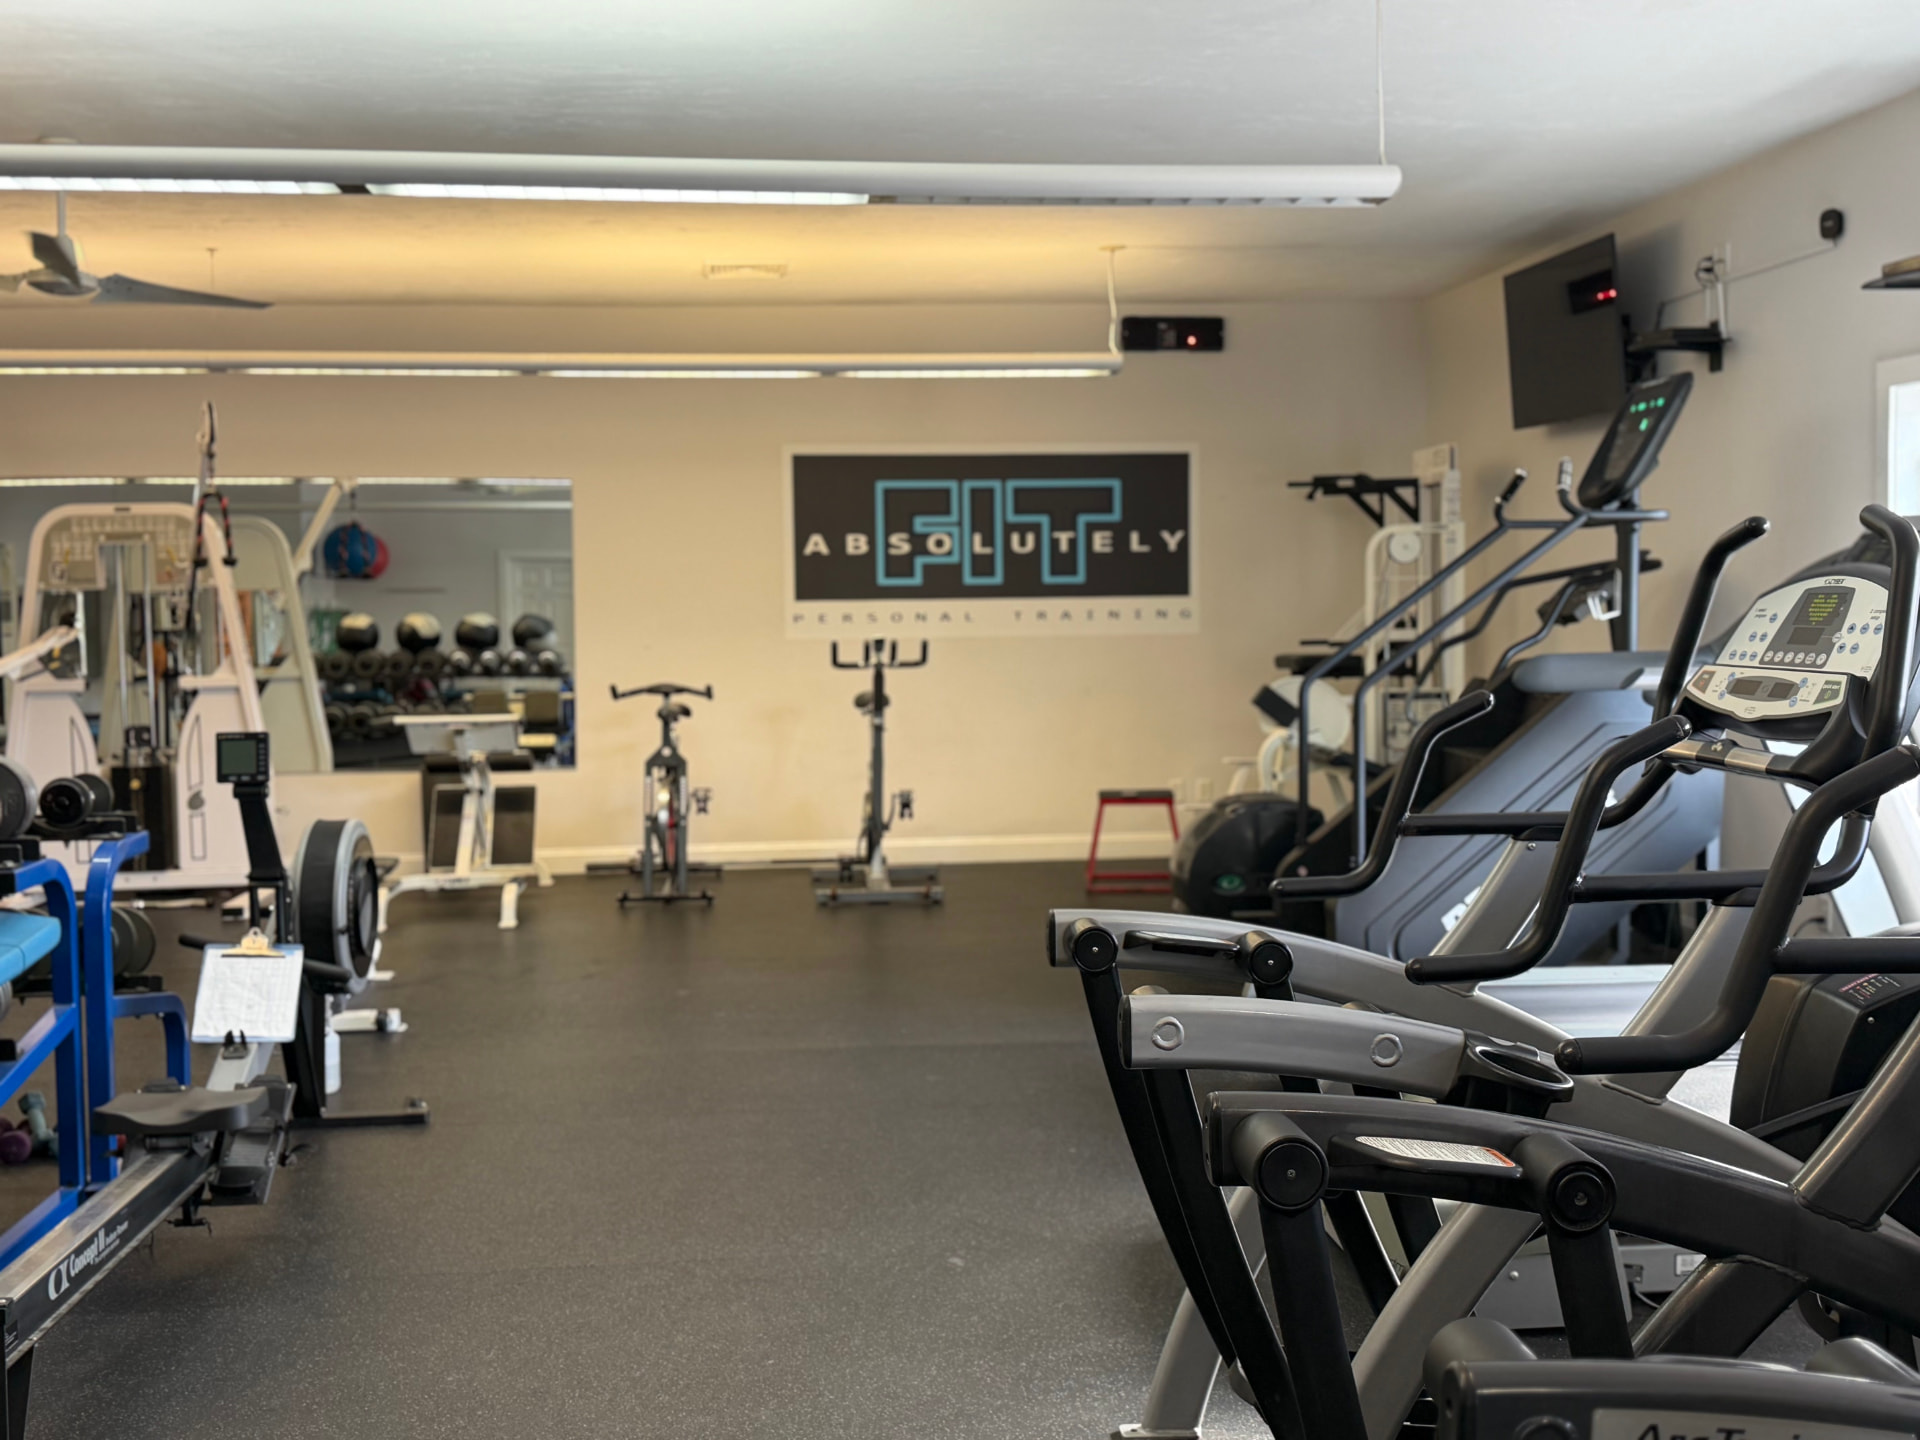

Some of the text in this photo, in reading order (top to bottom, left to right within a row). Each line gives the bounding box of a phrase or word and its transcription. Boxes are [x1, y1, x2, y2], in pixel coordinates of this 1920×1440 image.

[803, 529, 1185, 556] ABSOLUTELY
[875, 478, 1122, 586] FIT
[792, 608, 1192, 624] PERSONAL TRAINING
